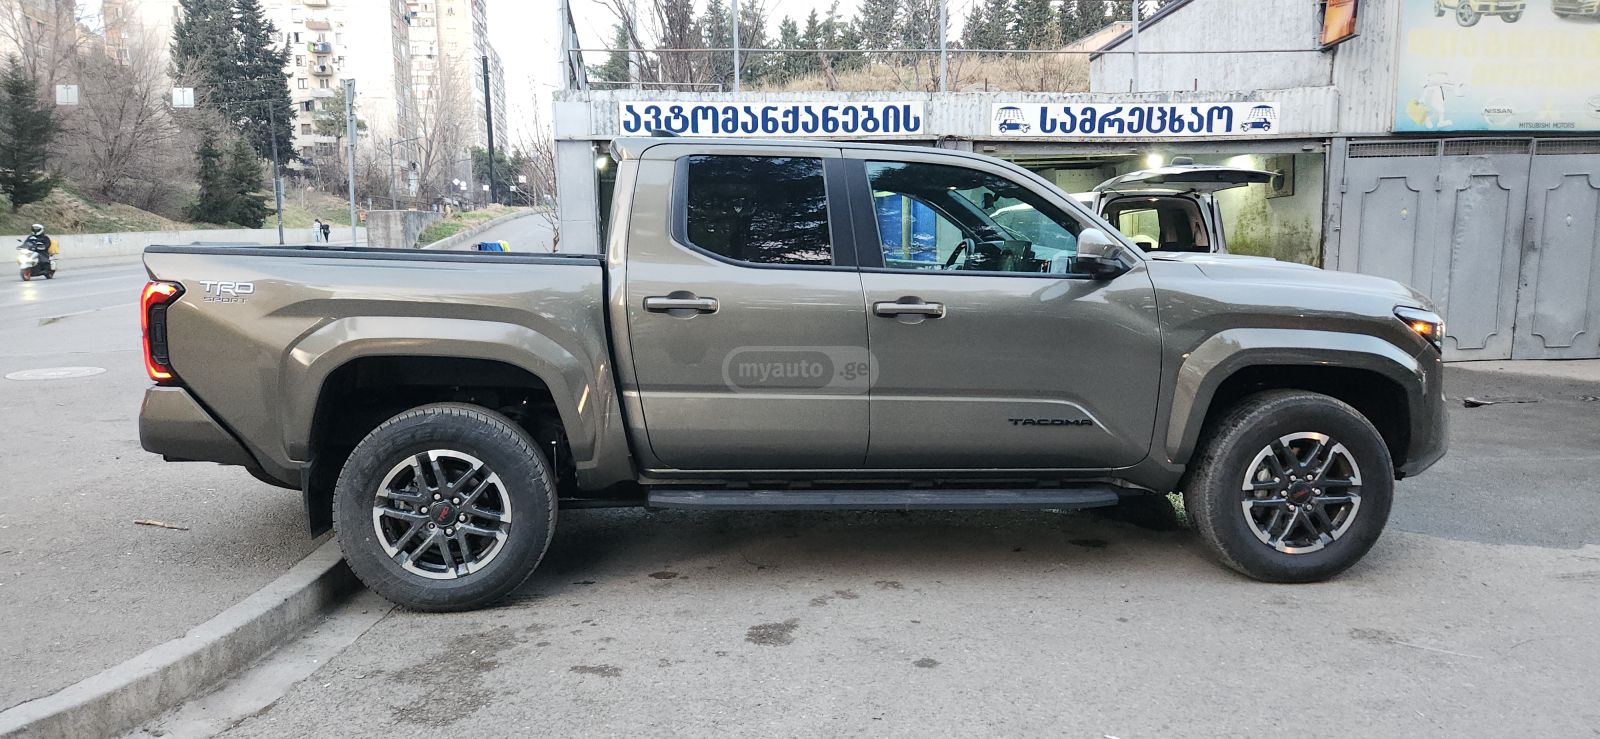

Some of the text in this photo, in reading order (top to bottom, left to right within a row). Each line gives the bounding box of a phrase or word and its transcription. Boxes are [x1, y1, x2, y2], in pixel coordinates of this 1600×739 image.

[623, 104, 921, 134] ავტომანქანების
[1039, 105, 1233, 134] სამრეცხაო
[200, 280, 255, 297] TRD
[1007, 418, 1093, 426] TACOMA
